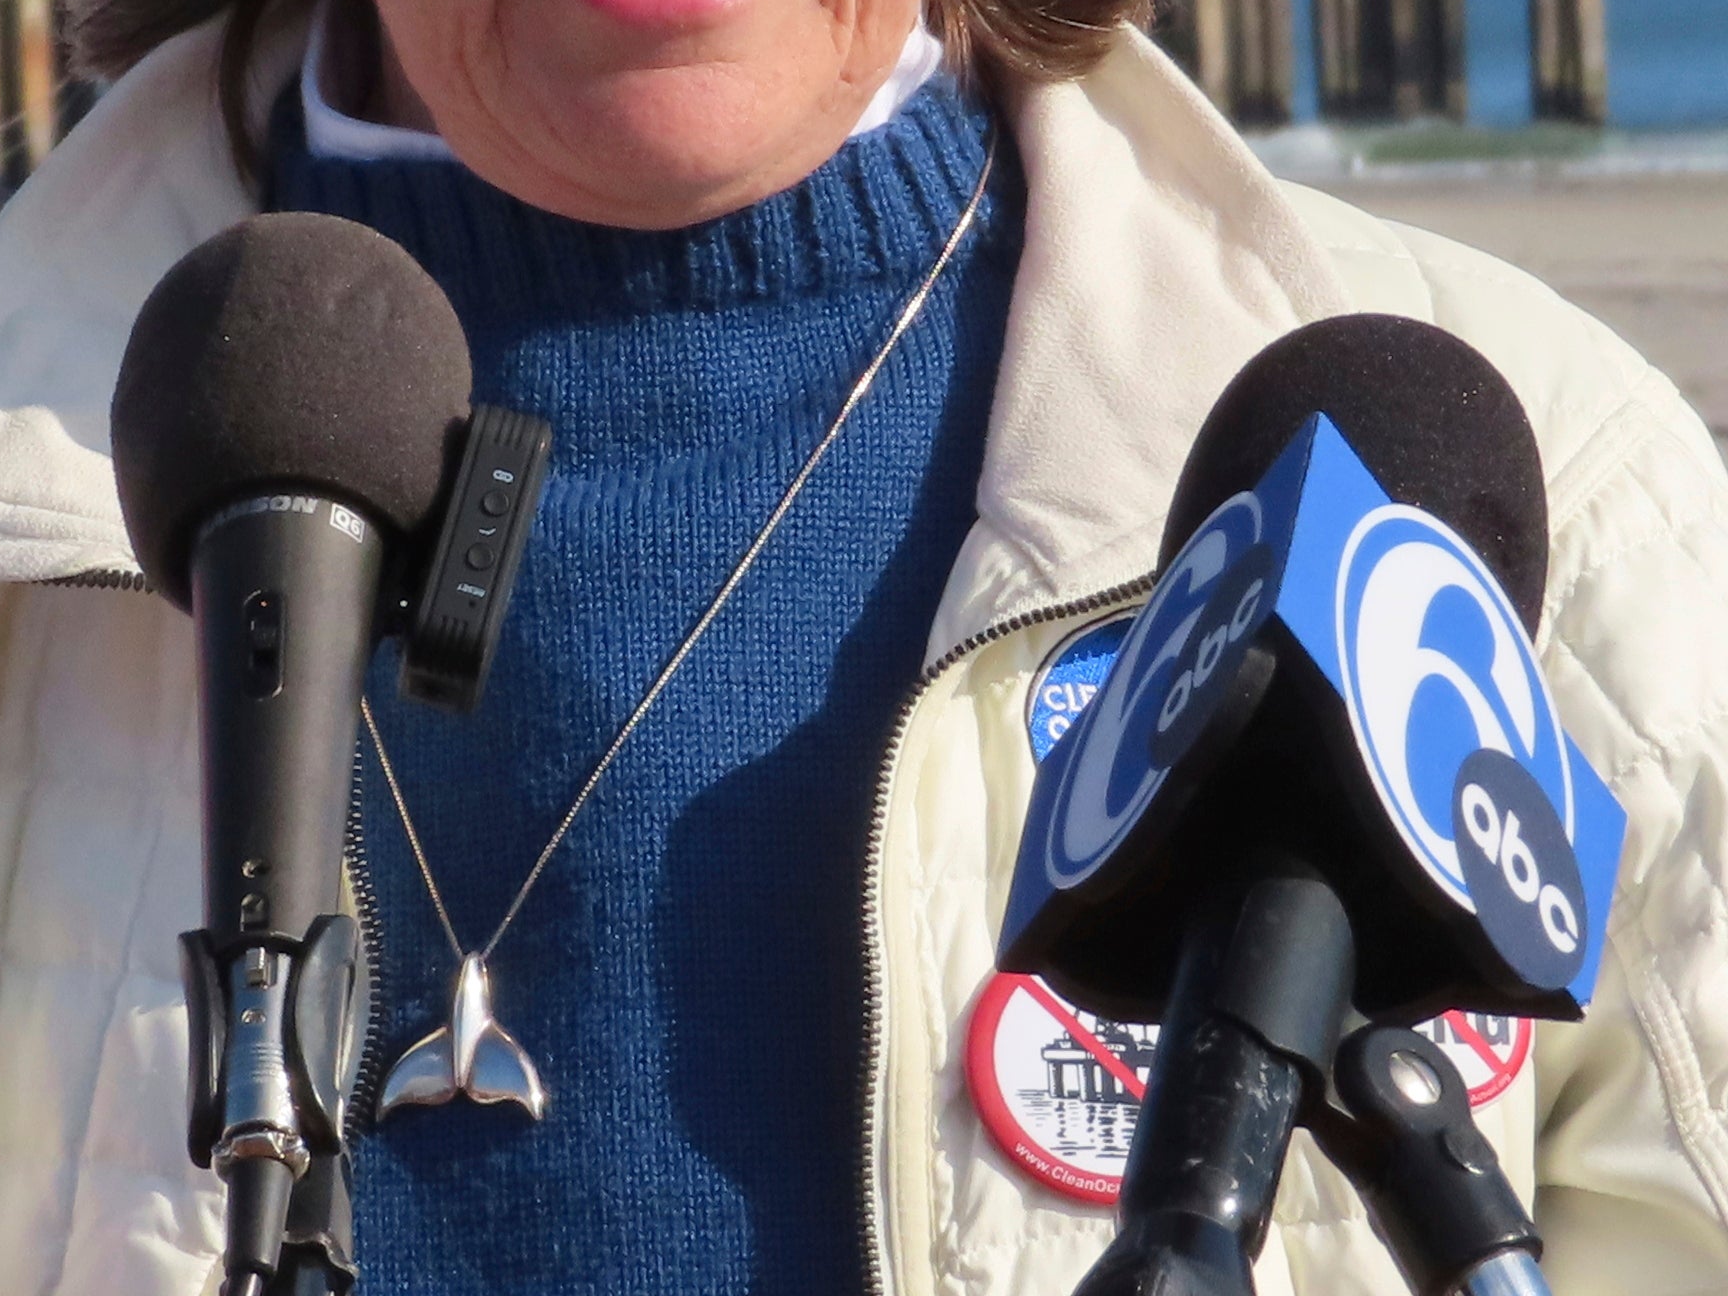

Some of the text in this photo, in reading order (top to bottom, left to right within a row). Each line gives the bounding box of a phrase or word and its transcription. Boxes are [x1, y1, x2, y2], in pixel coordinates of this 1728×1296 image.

[335, 509, 361, 536] Q6
[1157, 578, 1263, 733] abc
[1357, 542, 1536, 884] 6
[1461, 783, 1578, 953] abc
